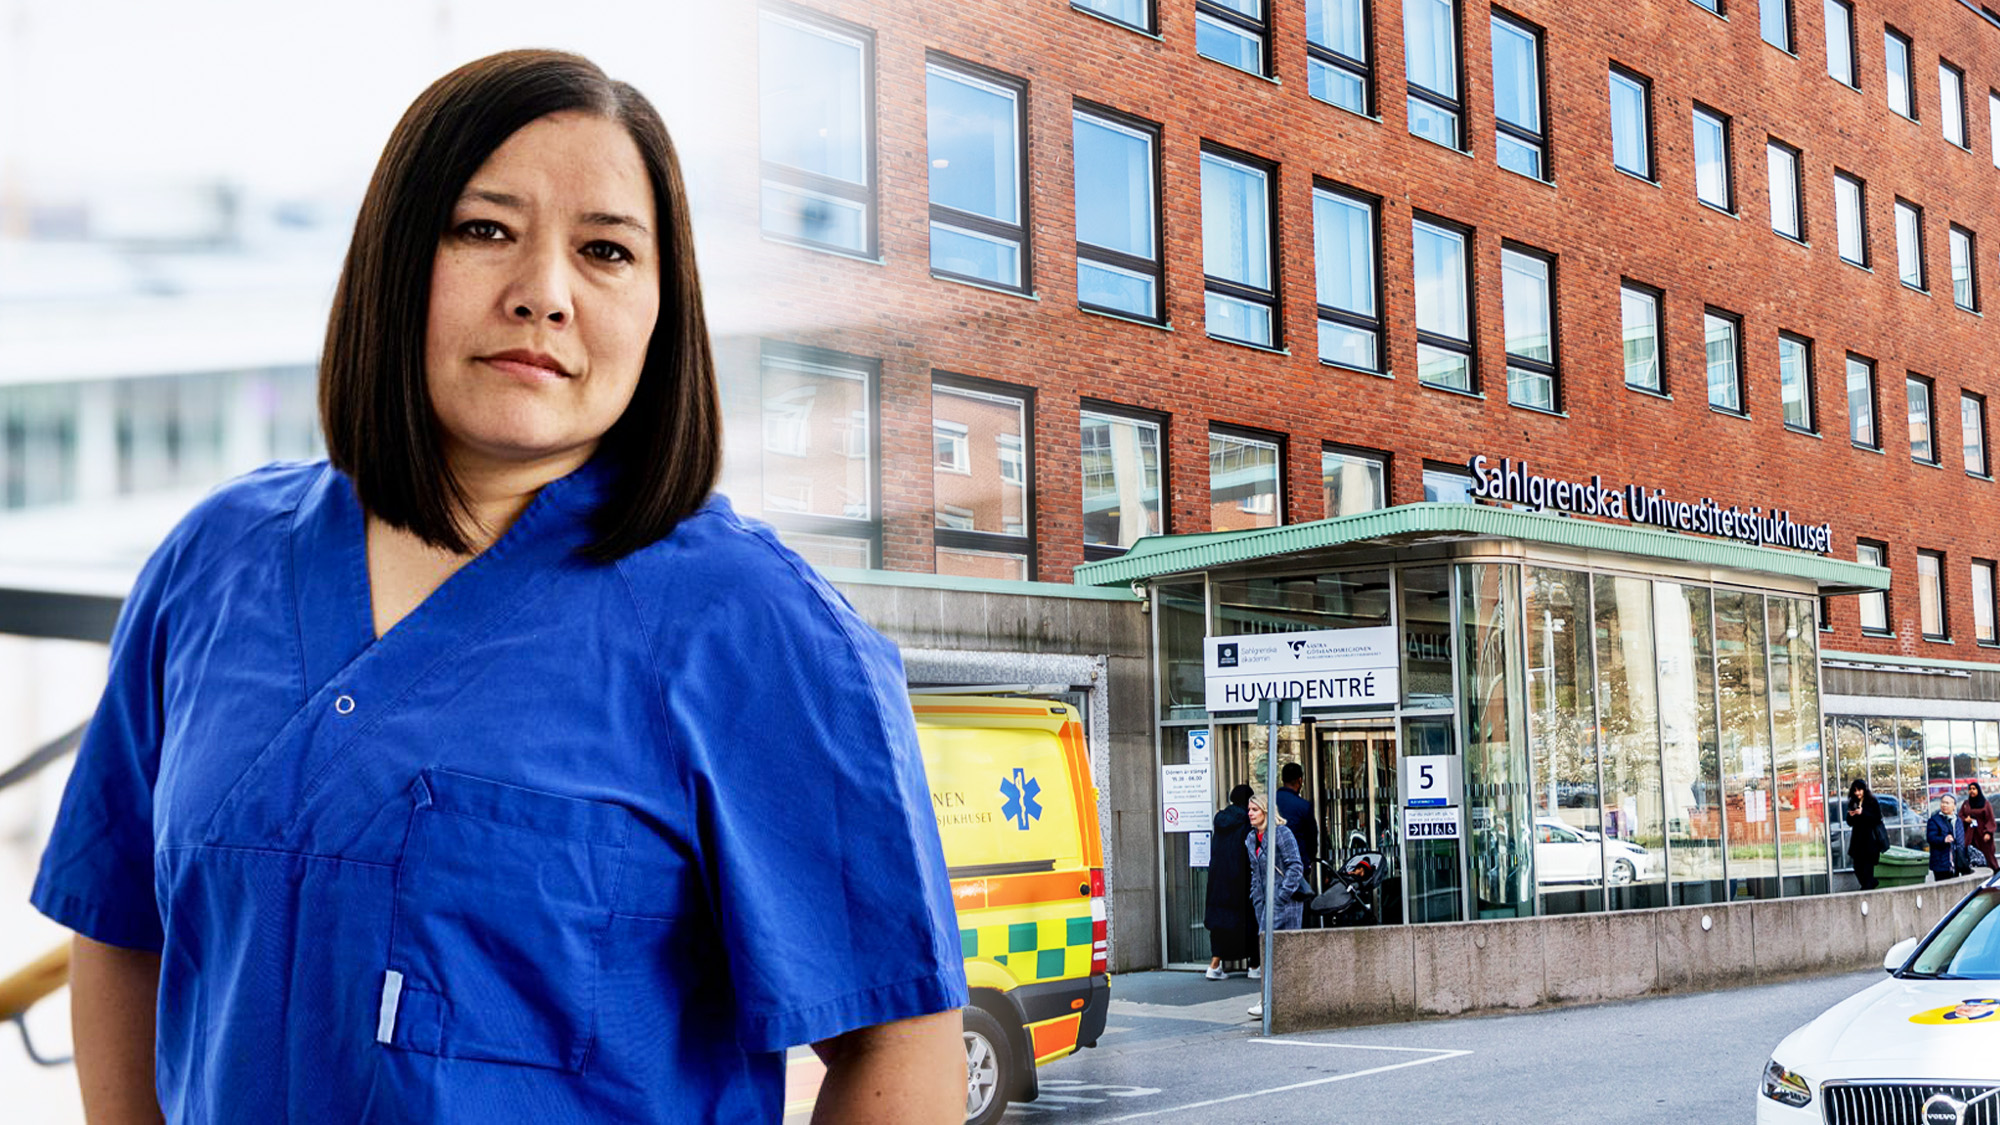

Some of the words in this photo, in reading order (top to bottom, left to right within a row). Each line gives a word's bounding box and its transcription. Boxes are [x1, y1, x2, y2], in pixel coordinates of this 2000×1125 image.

[1469, 455, 1623, 518] Sahlgrenska
[1625, 484, 1833, 553] Universitetssjukhuset
[1226, 672, 1374, 702] HUVUDENTRÉ
[1420, 765, 1433, 789] 5
